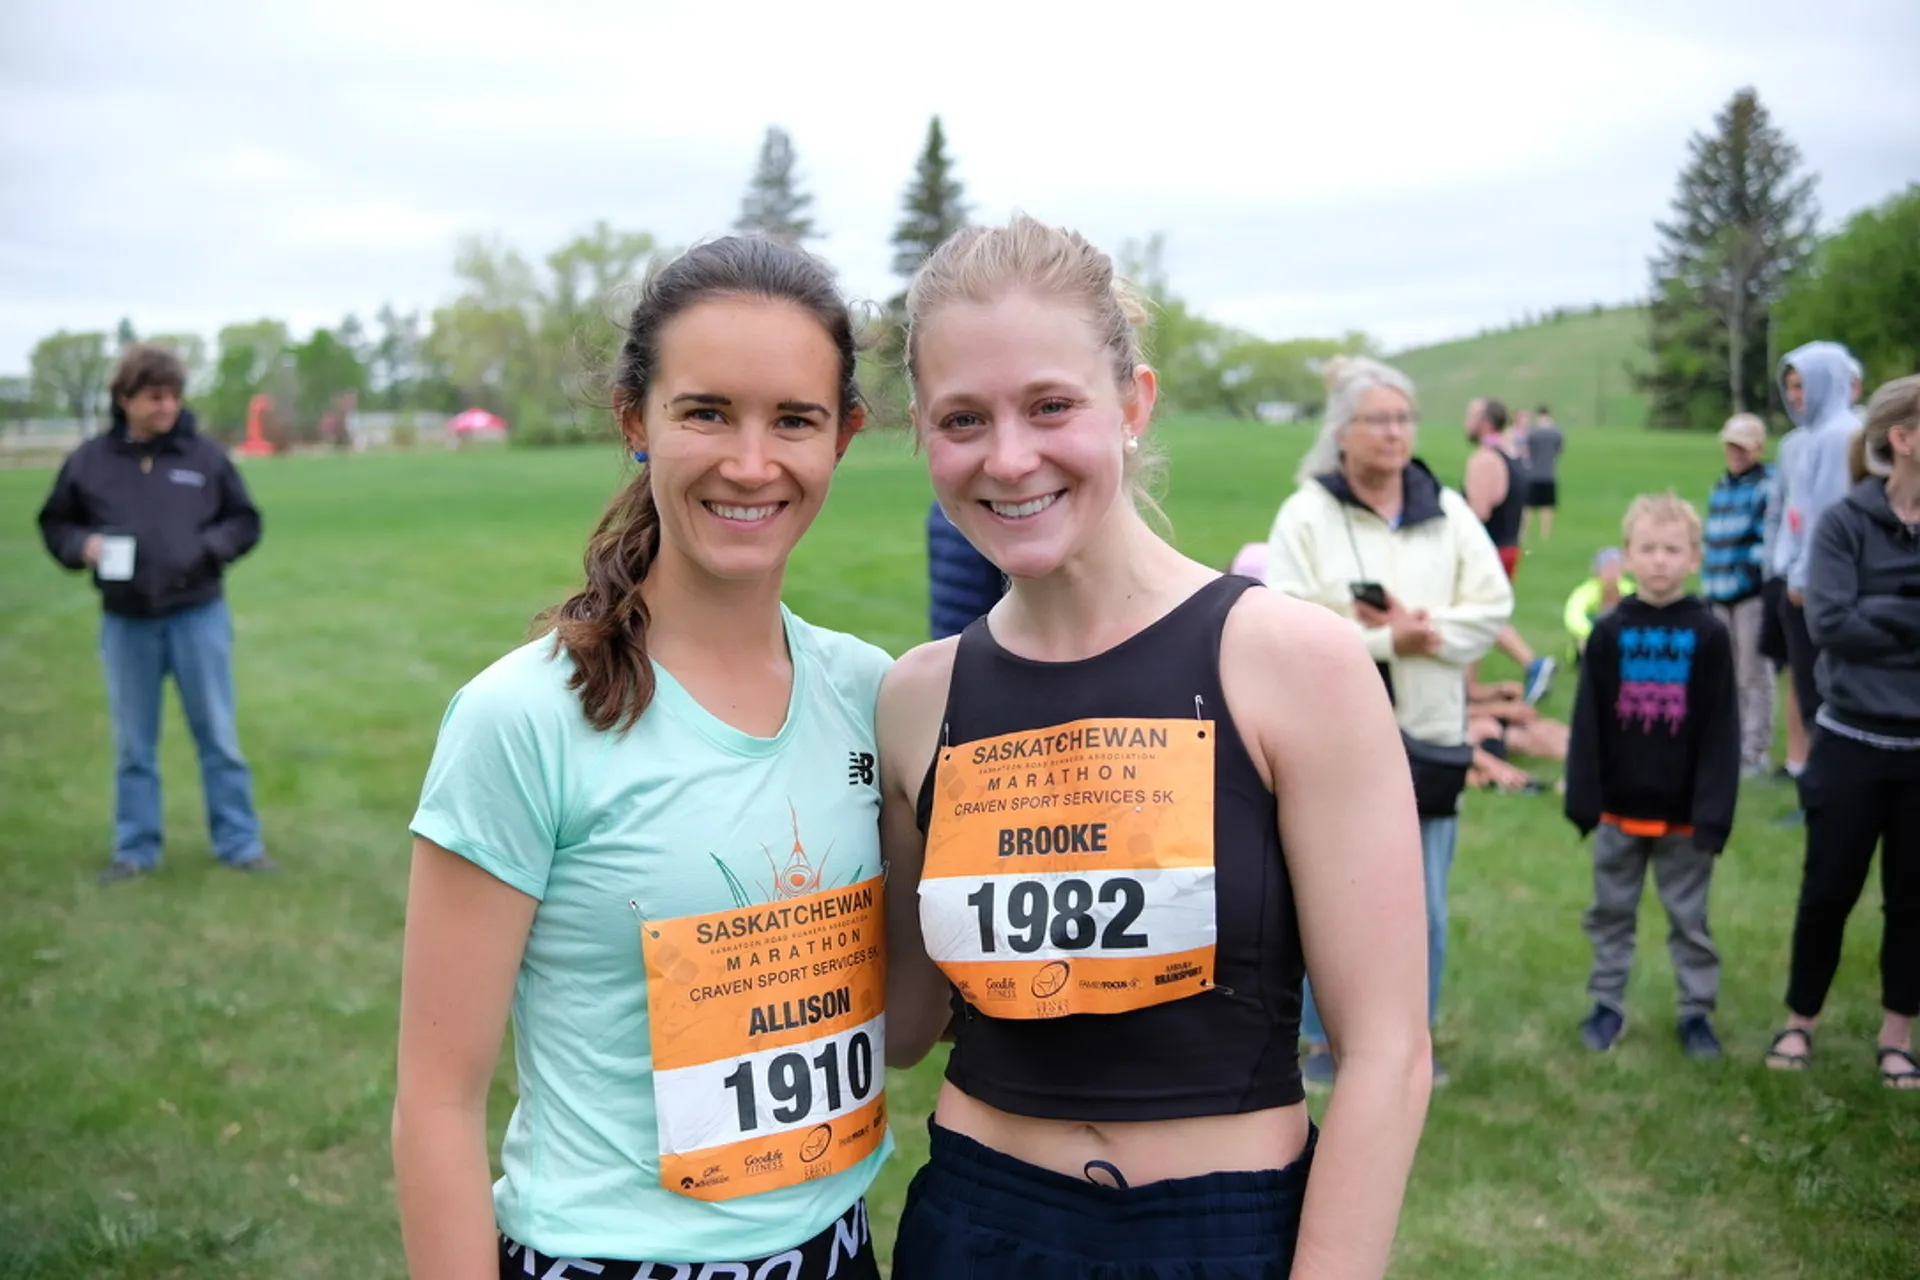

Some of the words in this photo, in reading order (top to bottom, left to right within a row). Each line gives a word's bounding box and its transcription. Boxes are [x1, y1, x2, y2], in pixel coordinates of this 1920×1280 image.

[972, 727, 1168, 765] SASKATCHEWAN
[1087, 753, 1156, 761] ASSOCIATION
[987, 765, 1137, 791] MARATHON
[954, 799, 1007, 816] CRAVEN
[1011, 793, 1060, 811] SPORT
[1063, 789, 1145, 806] SERVICES
[1152, 789, 1174, 804] 5K
[998, 823, 1108, 857] BROOKE
[696, 888, 874, 945] SASKATCHEWAN
[967, 877, 1149, 954] 1982
[726, 928, 861, 971] MARATHON
[689, 977, 753, 1002] CRAVEN
[758, 965, 808, 989] SPORT
[812, 949, 866, 977] SERVICES
[748, 986, 851, 1037] ALLISON
[724, 1032, 872, 1132] 1910
